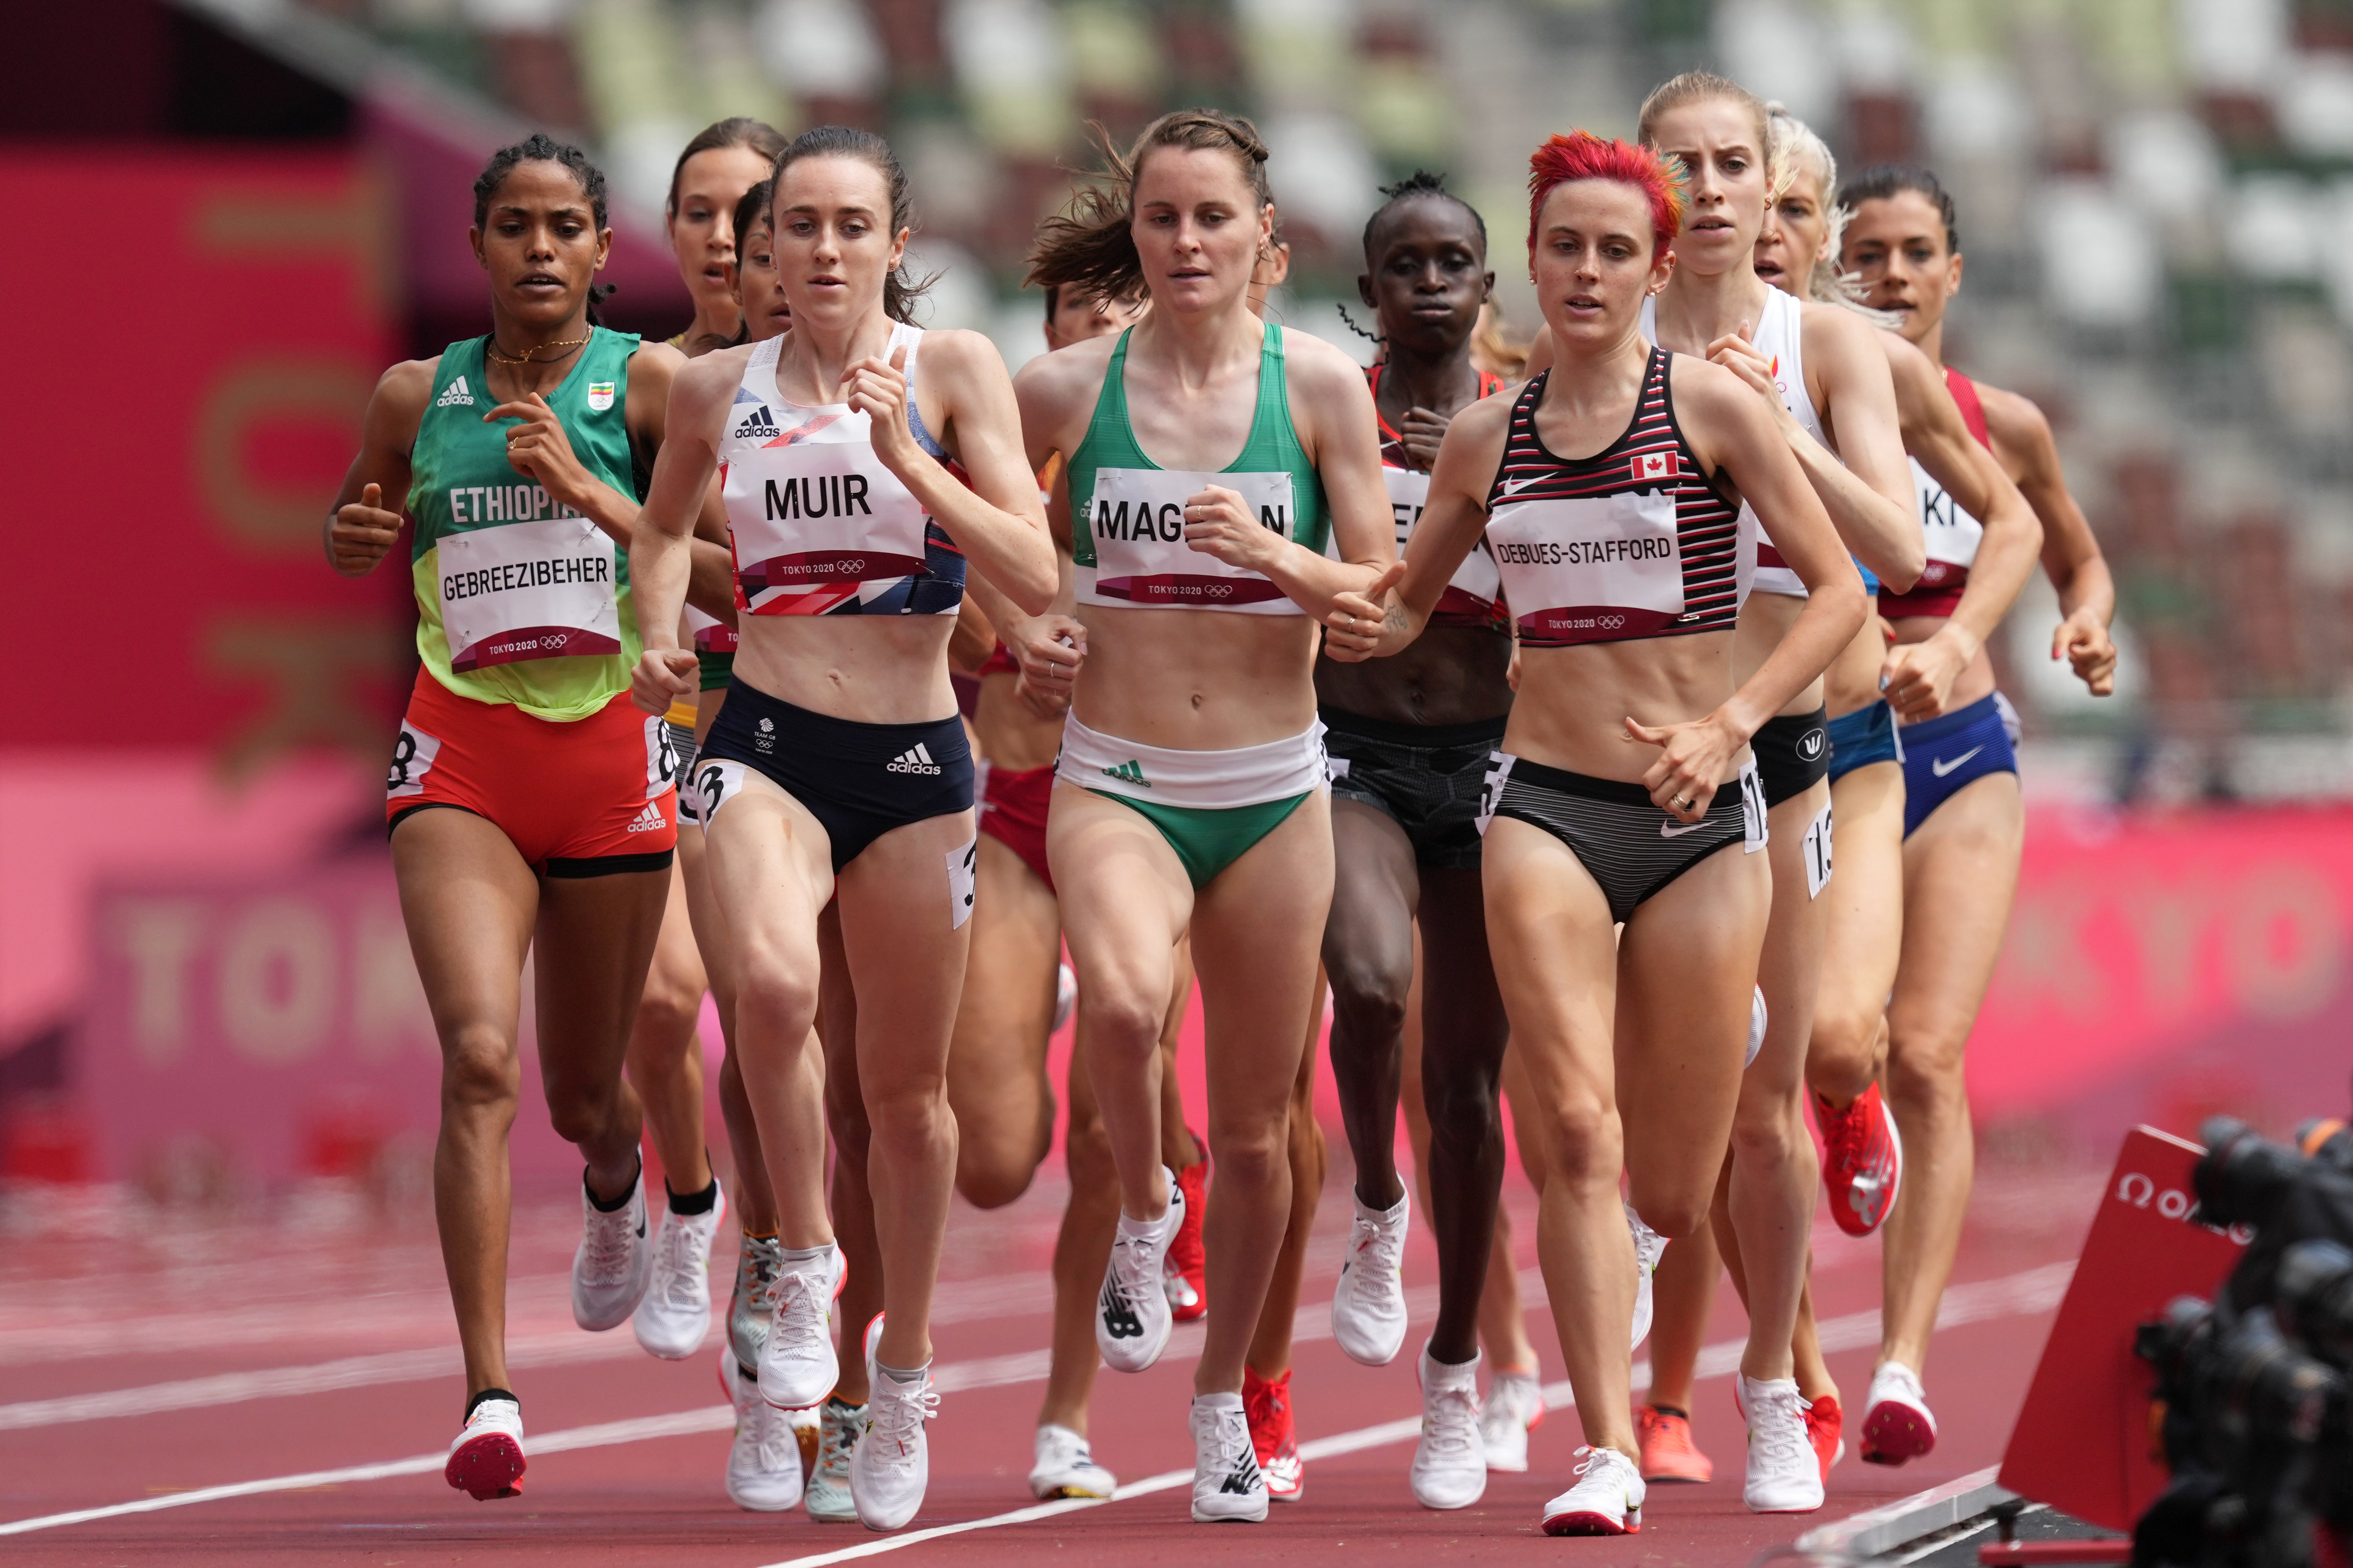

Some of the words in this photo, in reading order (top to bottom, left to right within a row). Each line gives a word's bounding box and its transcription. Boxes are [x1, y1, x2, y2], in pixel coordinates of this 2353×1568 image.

[437, 394, 474, 407] adidas
[735, 425, 780, 438] adidas
[765, 474, 872, 521] MUIR
[1098, 500, 1284, 543] MAGN
[1497, 538, 1671, 565] DEBUES-STAFFORD
[783, 566, 811, 575] TOKYO
[813, 564, 834, 573] 2020
[444, 558, 607, 601] GEBREEZIBEHER
[1149, 585, 1178, 594] TOKYO
[1180, 586, 1201, 595] 2020
[1549, 620, 1572, 628] TOKYO
[1574, 619, 1594, 628] 2020
[490, 644, 515, 655] TOKYO
[516, 641, 537, 652] 2020
[658, 716, 676, 782] 8
[387, 731, 416, 790] 8
[886, 762, 941, 775] adidas
[698, 766, 724, 822] 3
[627, 818, 666, 832] adidas
